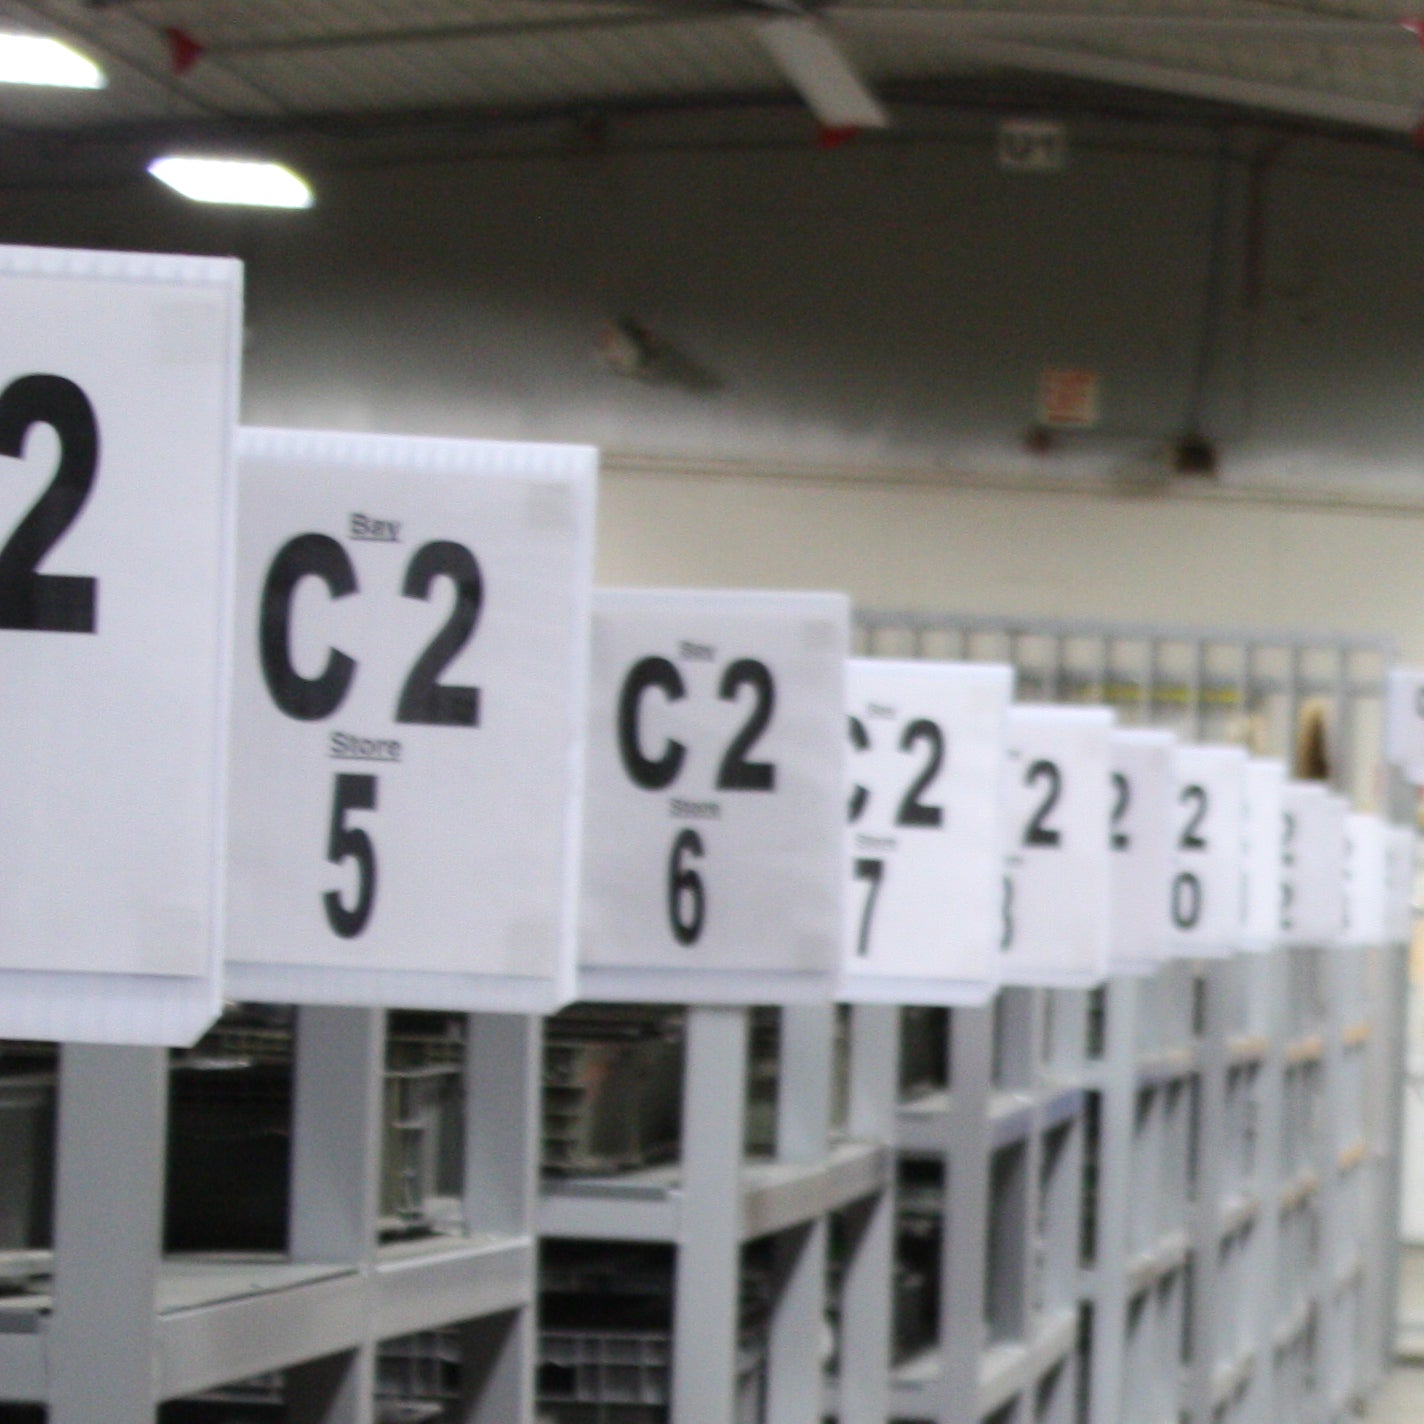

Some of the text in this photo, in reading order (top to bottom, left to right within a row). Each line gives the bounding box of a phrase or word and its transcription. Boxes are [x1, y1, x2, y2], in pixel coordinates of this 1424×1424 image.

[328, 731, 403, 762] Store
[1022, 758, 1062, 848] 2
[1177, 784, 1208, 849] 2
[322, 773, 379, 939] 5
[667, 827, 706, 947] 6
[854, 858, 884, 957] 7
